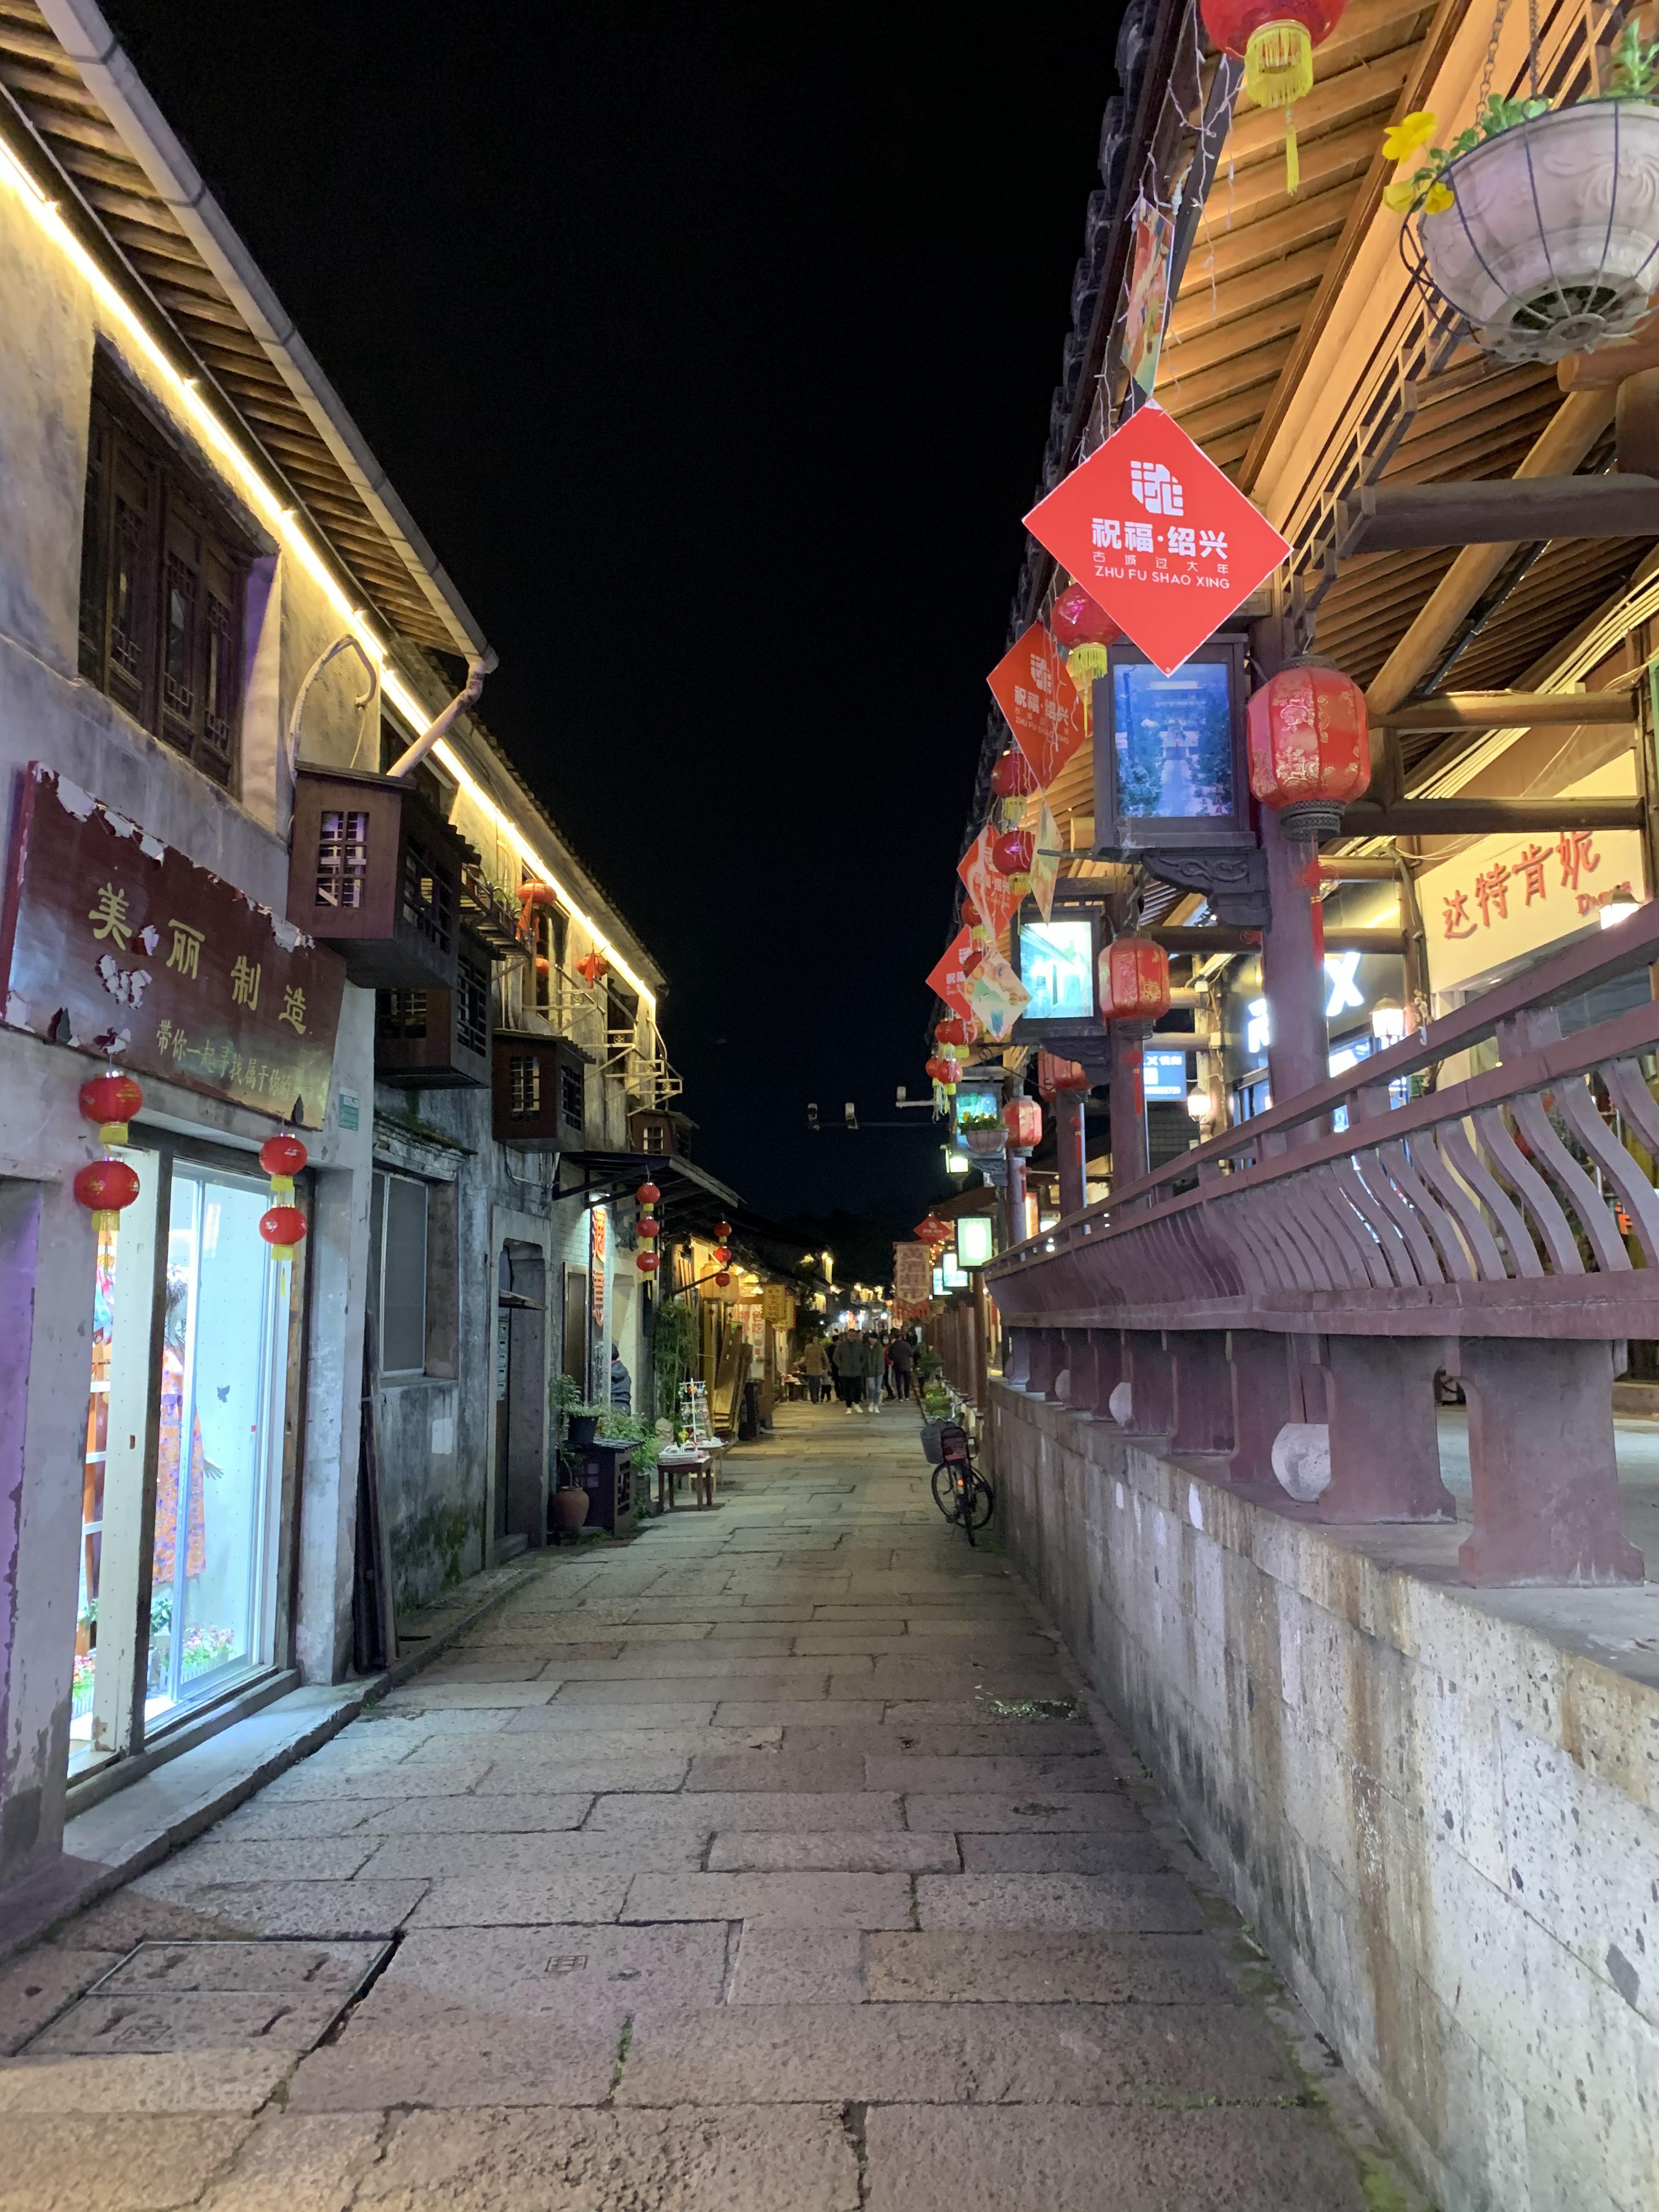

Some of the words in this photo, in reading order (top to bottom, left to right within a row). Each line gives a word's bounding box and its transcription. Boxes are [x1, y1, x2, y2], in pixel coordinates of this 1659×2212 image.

[1092, 518, 1228, 560] 祝福·绍兴
[1093, 551, 1229, 574] 古城过大年
[1094, 566, 1124, 578] ZHU
[1128, 569, 1147, 581] FU
[1152, 571, 1191, 586] SHAO
[1196, 575, 1230, 589] XING
[1014, 685, 1069, 726] 祝福·绍兴
[1442, 831, 1601, 939] 达特肯妮
[88, 882, 307, 1035] 美丽制造
[156, 1019, 314, 1107] 带你一起寻找属于你的
